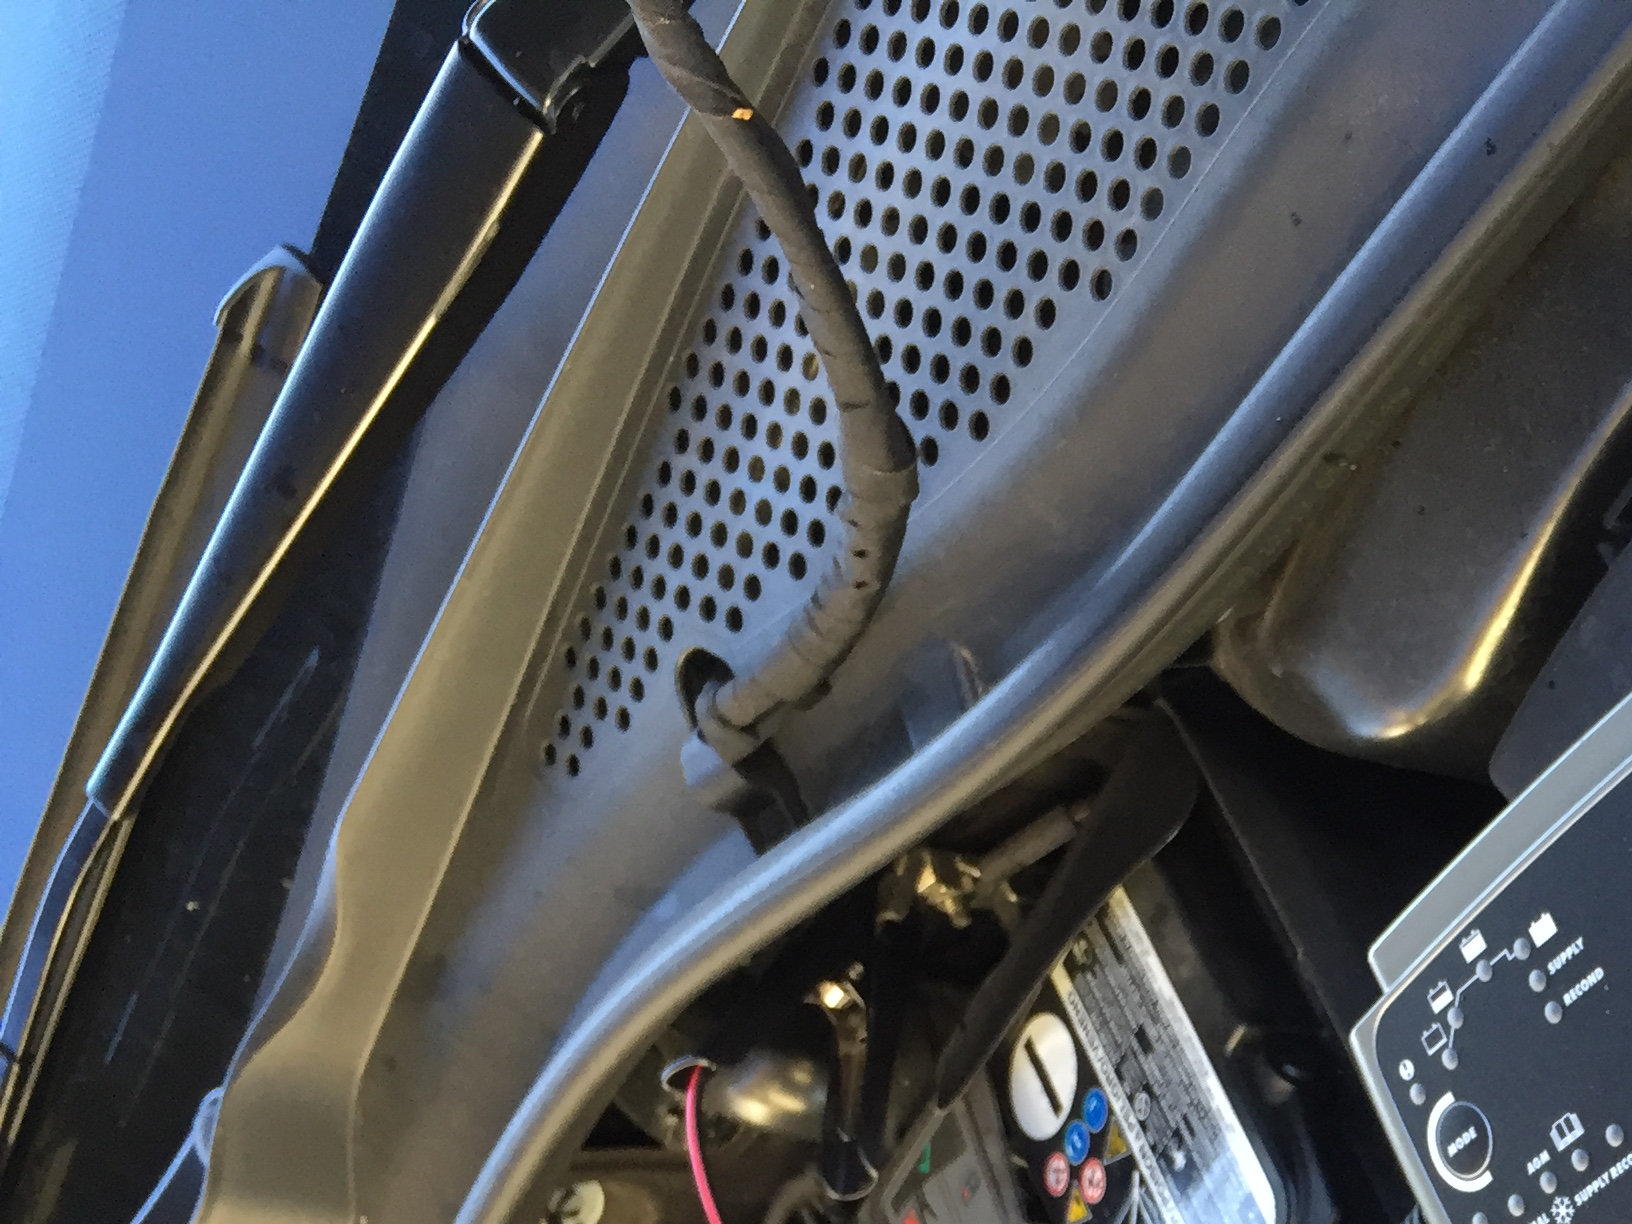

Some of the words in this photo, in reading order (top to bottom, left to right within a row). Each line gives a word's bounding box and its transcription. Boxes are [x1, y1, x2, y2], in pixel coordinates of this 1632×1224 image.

[1547, 936, 1584, 976] SUPPLY
[1562, 966, 1605, 1007] RECOND
[1447, 1126, 1478, 1157] MODE
[1526, 1149, 1551, 1176] AGM
[1574, 1171, 1611, 1206] SUPPLY
